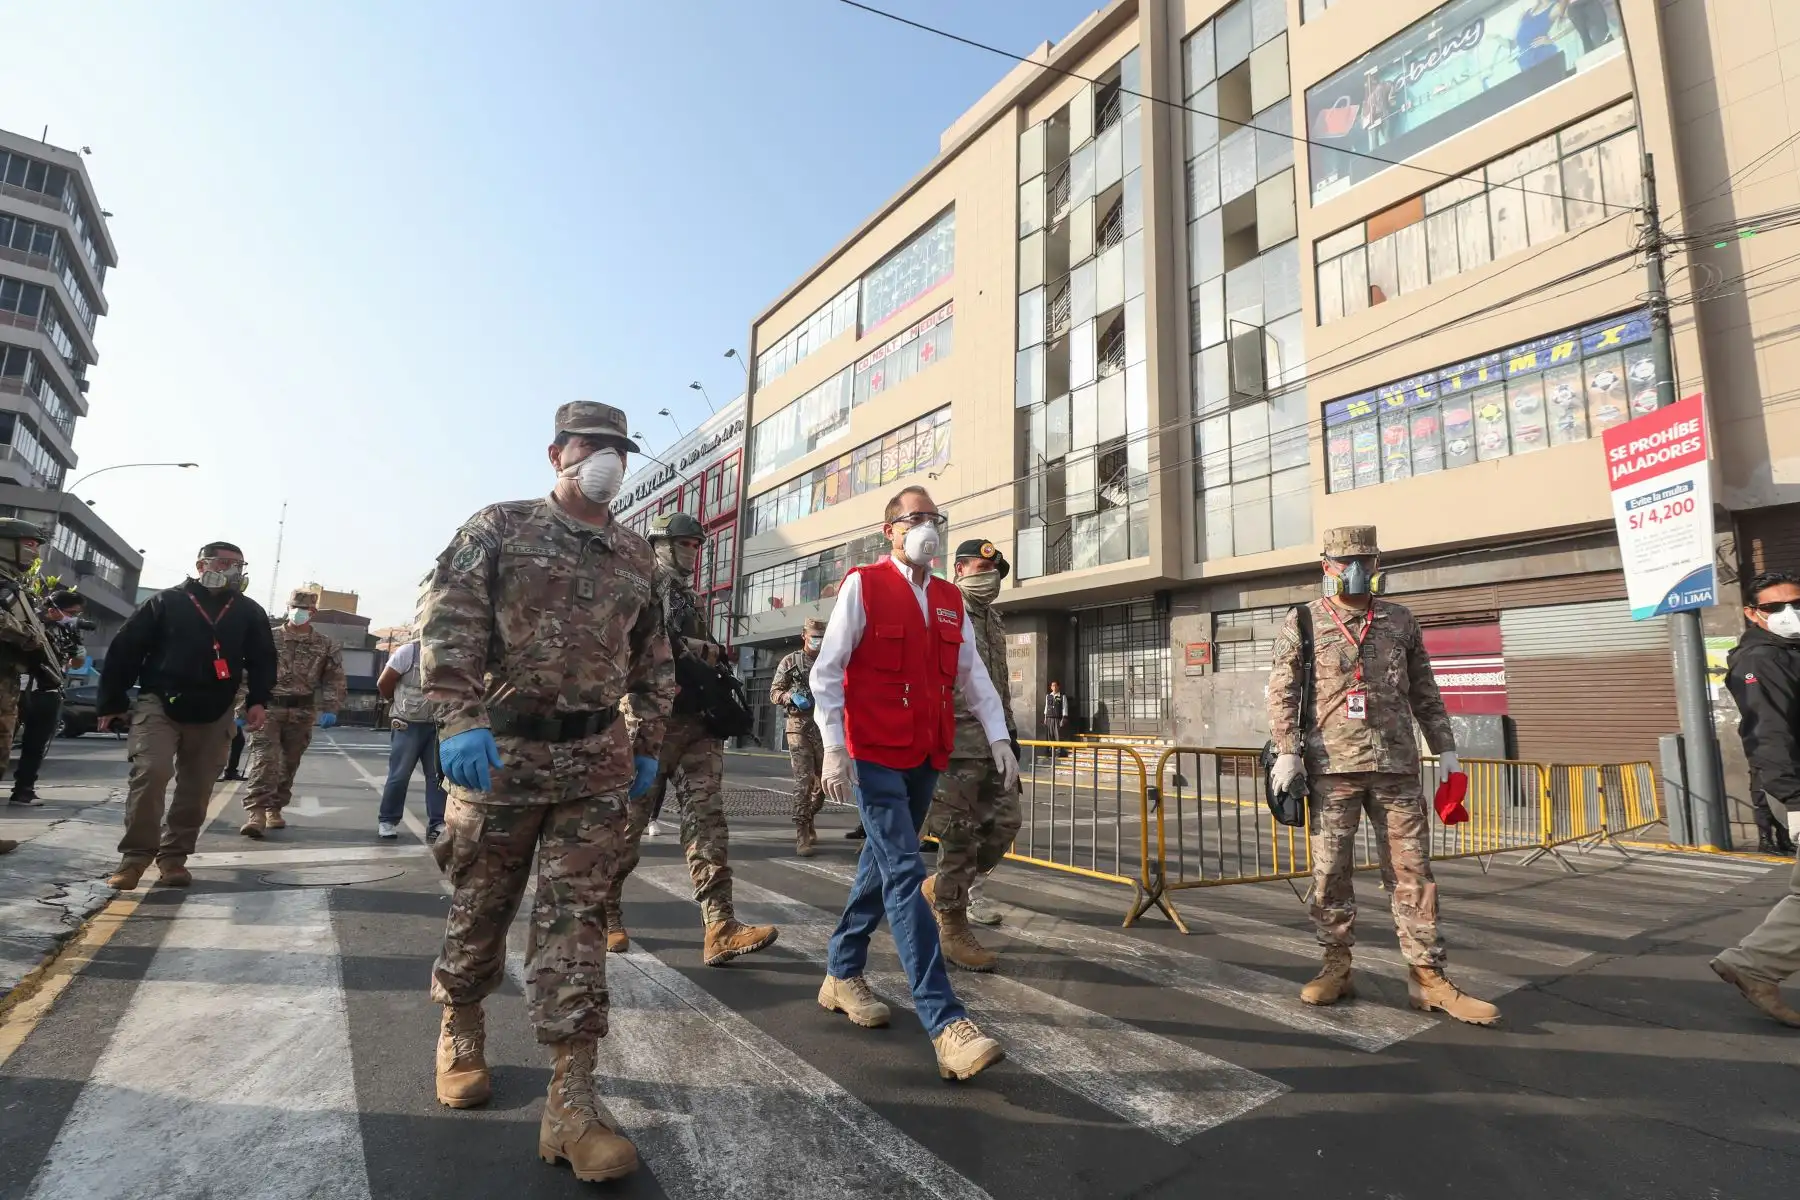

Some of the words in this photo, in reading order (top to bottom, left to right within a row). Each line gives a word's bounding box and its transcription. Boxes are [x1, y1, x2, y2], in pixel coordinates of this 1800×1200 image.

[1609, 446, 1627, 462] SE
[1629, 417, 1700, 456] PROHÍBE
[1612, 437, 1702, 481] JALADORES
[1652, 491, 1661, 502] la
[1662, 484, 1689, 500] multa
[1629, 510, 1644, 529] S/
[1648, 497, 1695, 524] 4,200
[1683, 591, 1712, 605] LIMA
